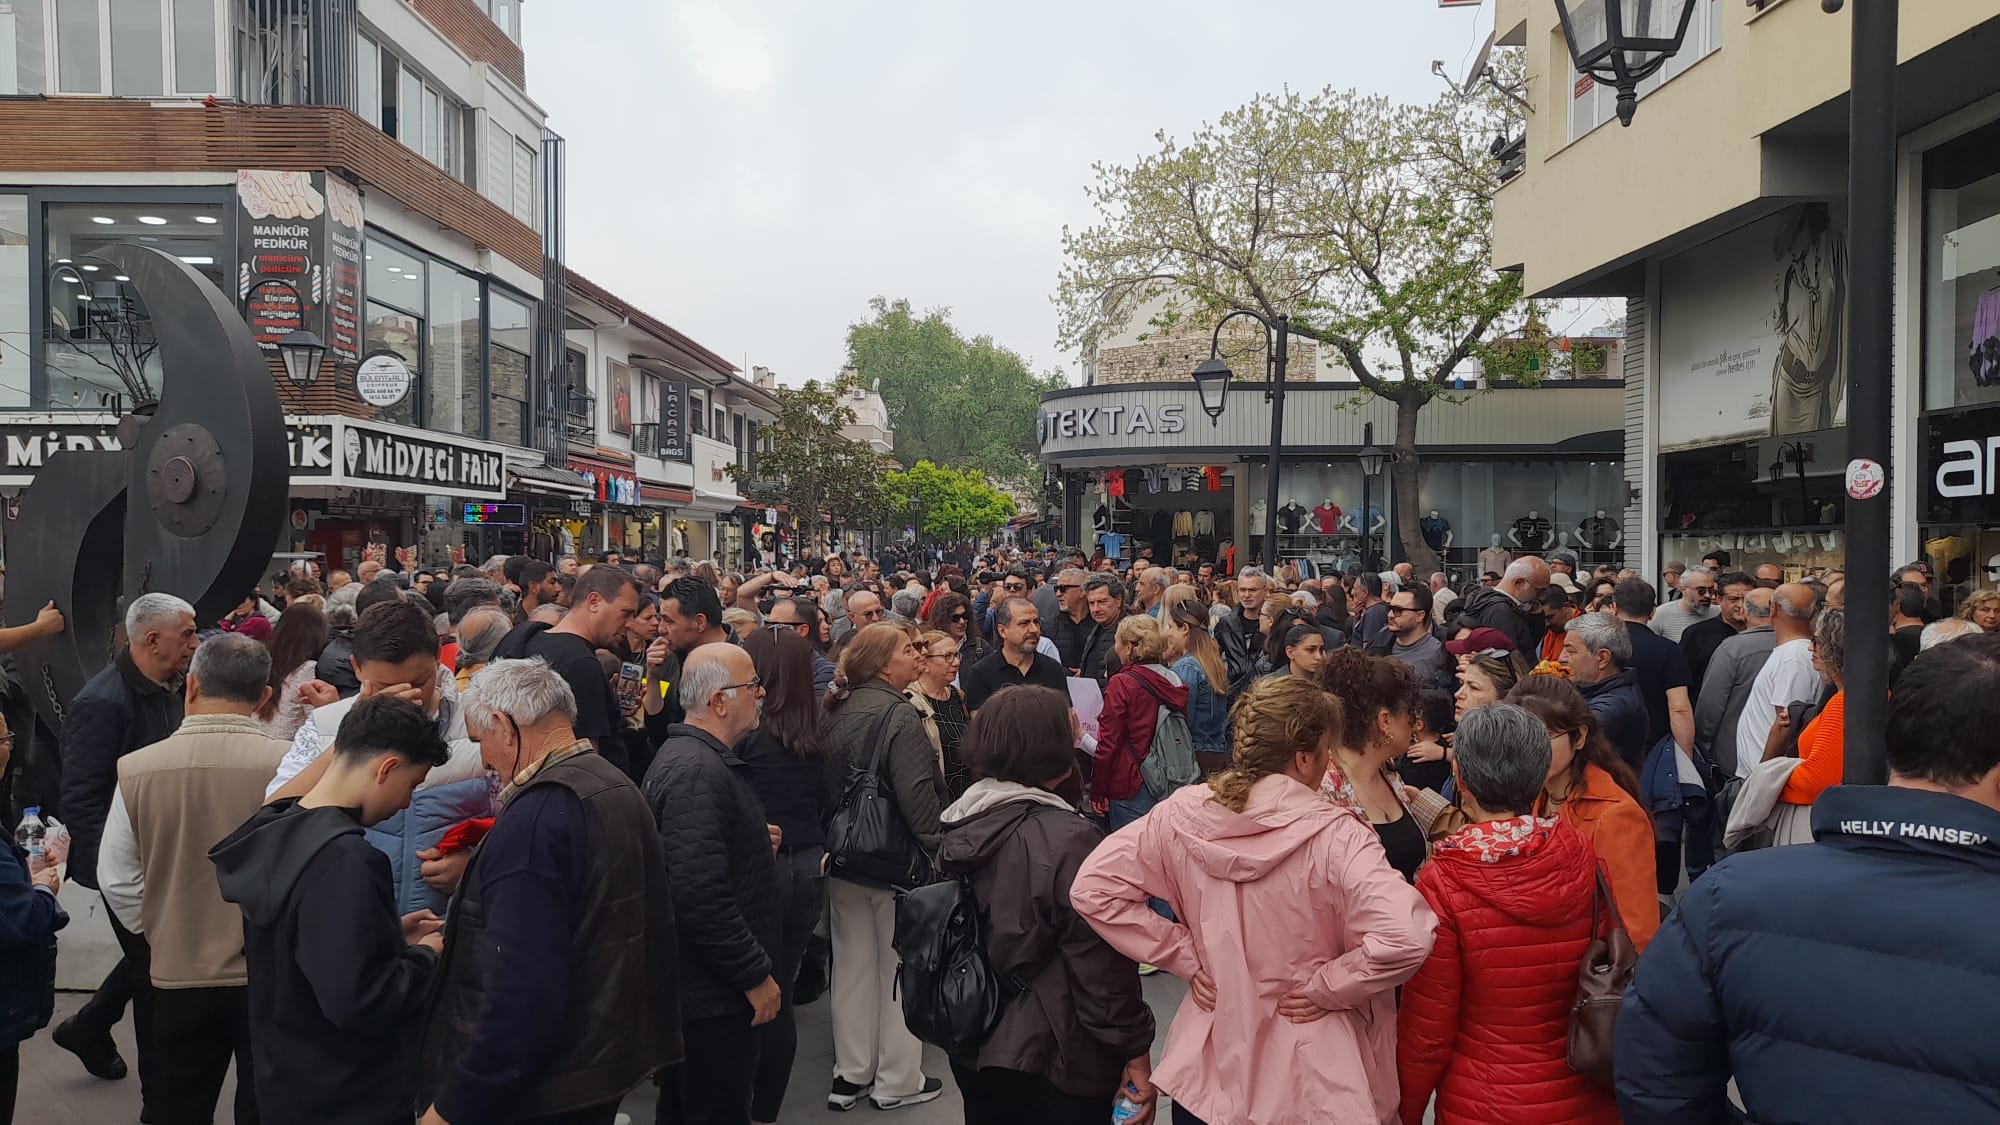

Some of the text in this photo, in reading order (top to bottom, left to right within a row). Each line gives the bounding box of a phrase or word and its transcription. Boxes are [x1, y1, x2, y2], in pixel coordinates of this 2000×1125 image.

[253, 224, 309, 237] MANİKÜR
[254, 237, 308, 250] PEDİKÜR
[661, 447, 684, 456] BAGS
[1840, 820, 1988, 846] HELLY HANSEN
